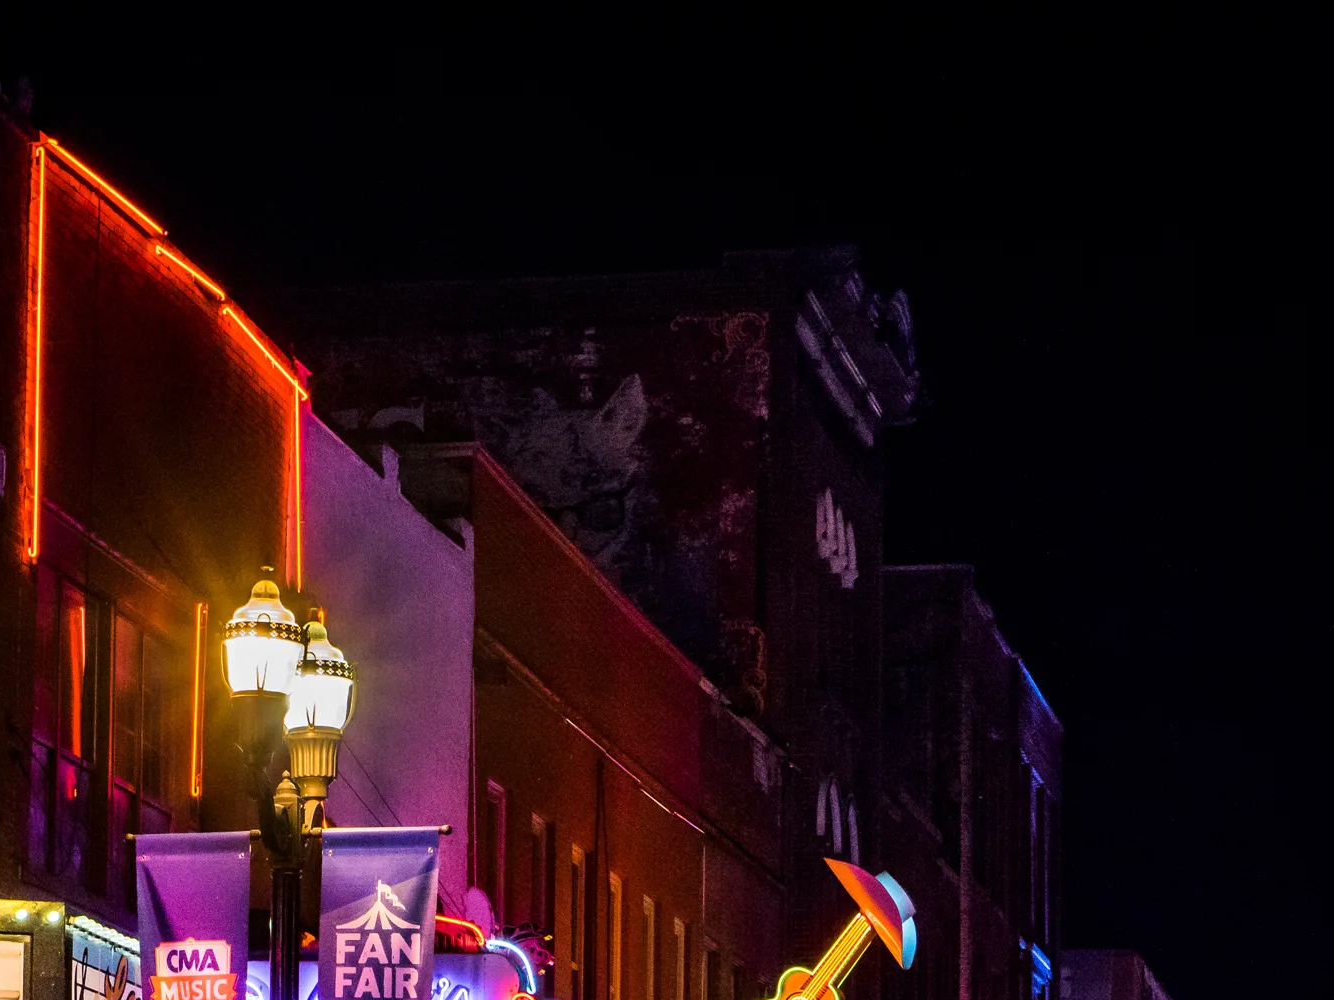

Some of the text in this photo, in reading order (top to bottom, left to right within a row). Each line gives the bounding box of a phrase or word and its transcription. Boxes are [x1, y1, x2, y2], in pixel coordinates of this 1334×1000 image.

[166, 949, 220, 973] CMA
[335, 932, 421, 964] FAN
[160, 979, 227, 1000] MUSIC
[334, 966, 419, 998] FAIR
